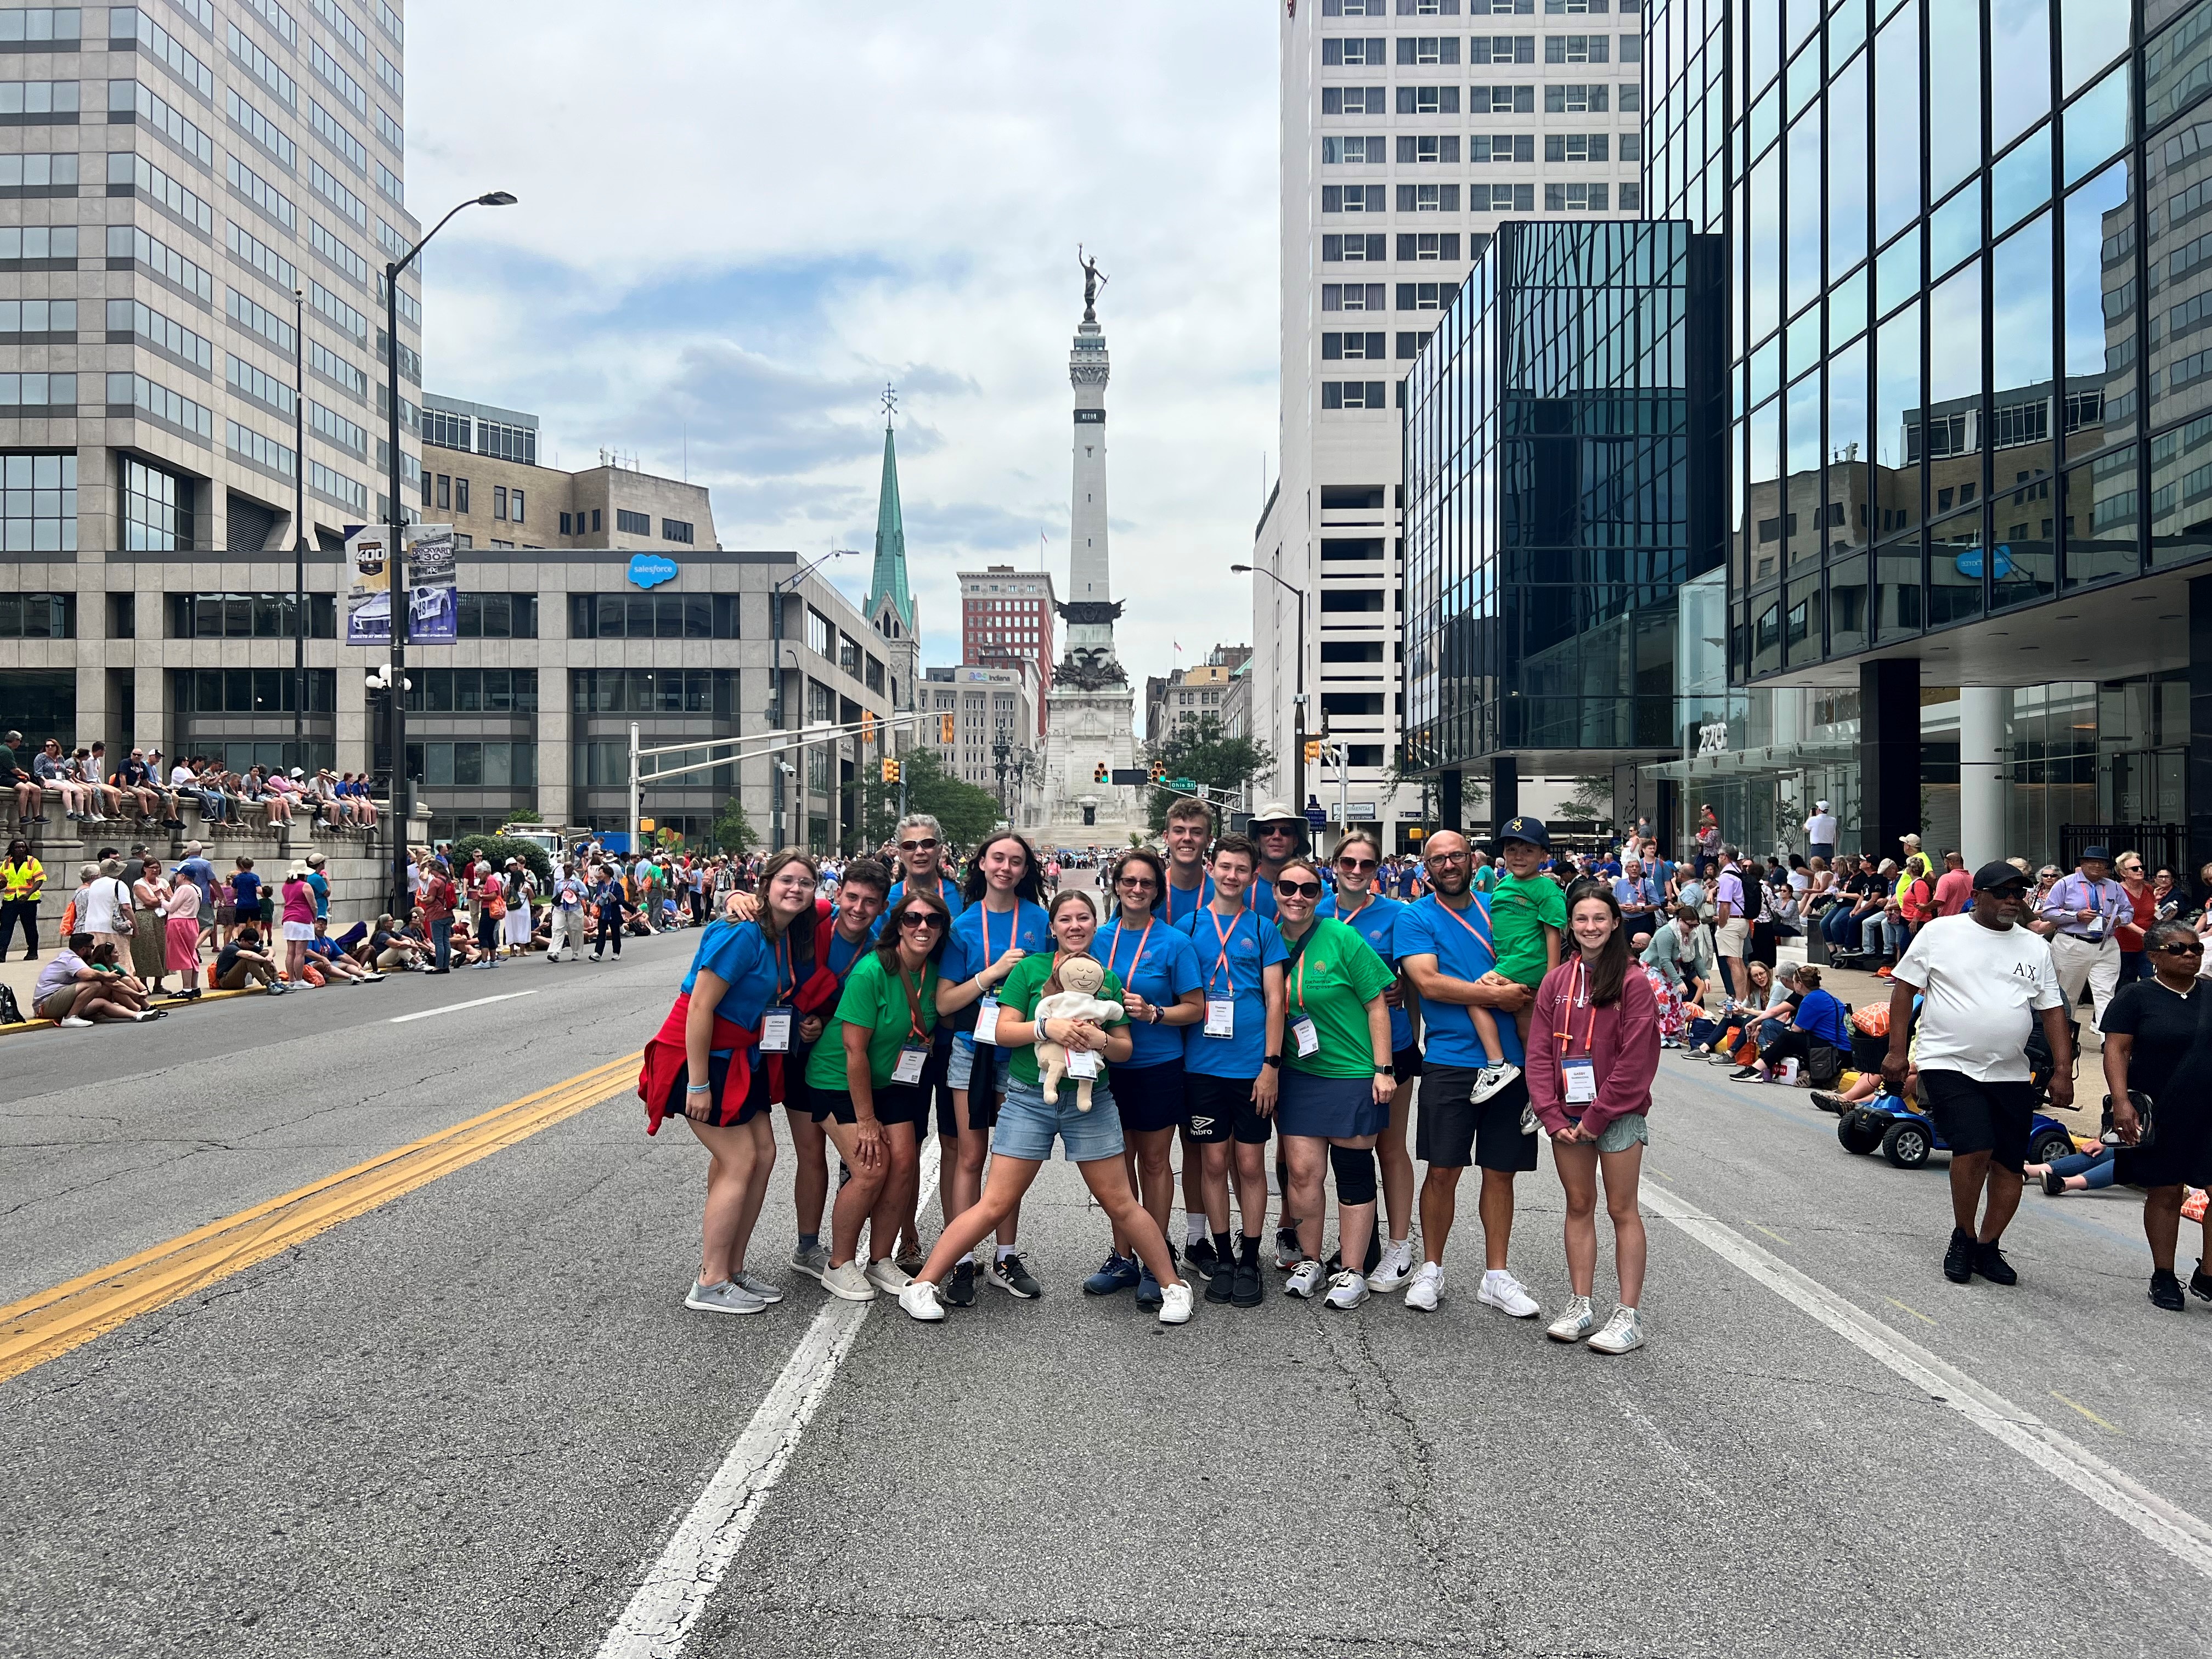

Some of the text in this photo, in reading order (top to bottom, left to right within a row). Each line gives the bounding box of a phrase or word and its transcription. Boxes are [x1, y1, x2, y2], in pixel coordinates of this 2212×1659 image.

[355, 548, 386, 562] 400
[411, 547, 451, 556] BRICKYARD
[634, 565, 673, 574] salesforce
[968, 672, 988, 681] aes
[1699, 722, 1728, 753] 220
[1190, 1127, 1212, 1136] mbro
